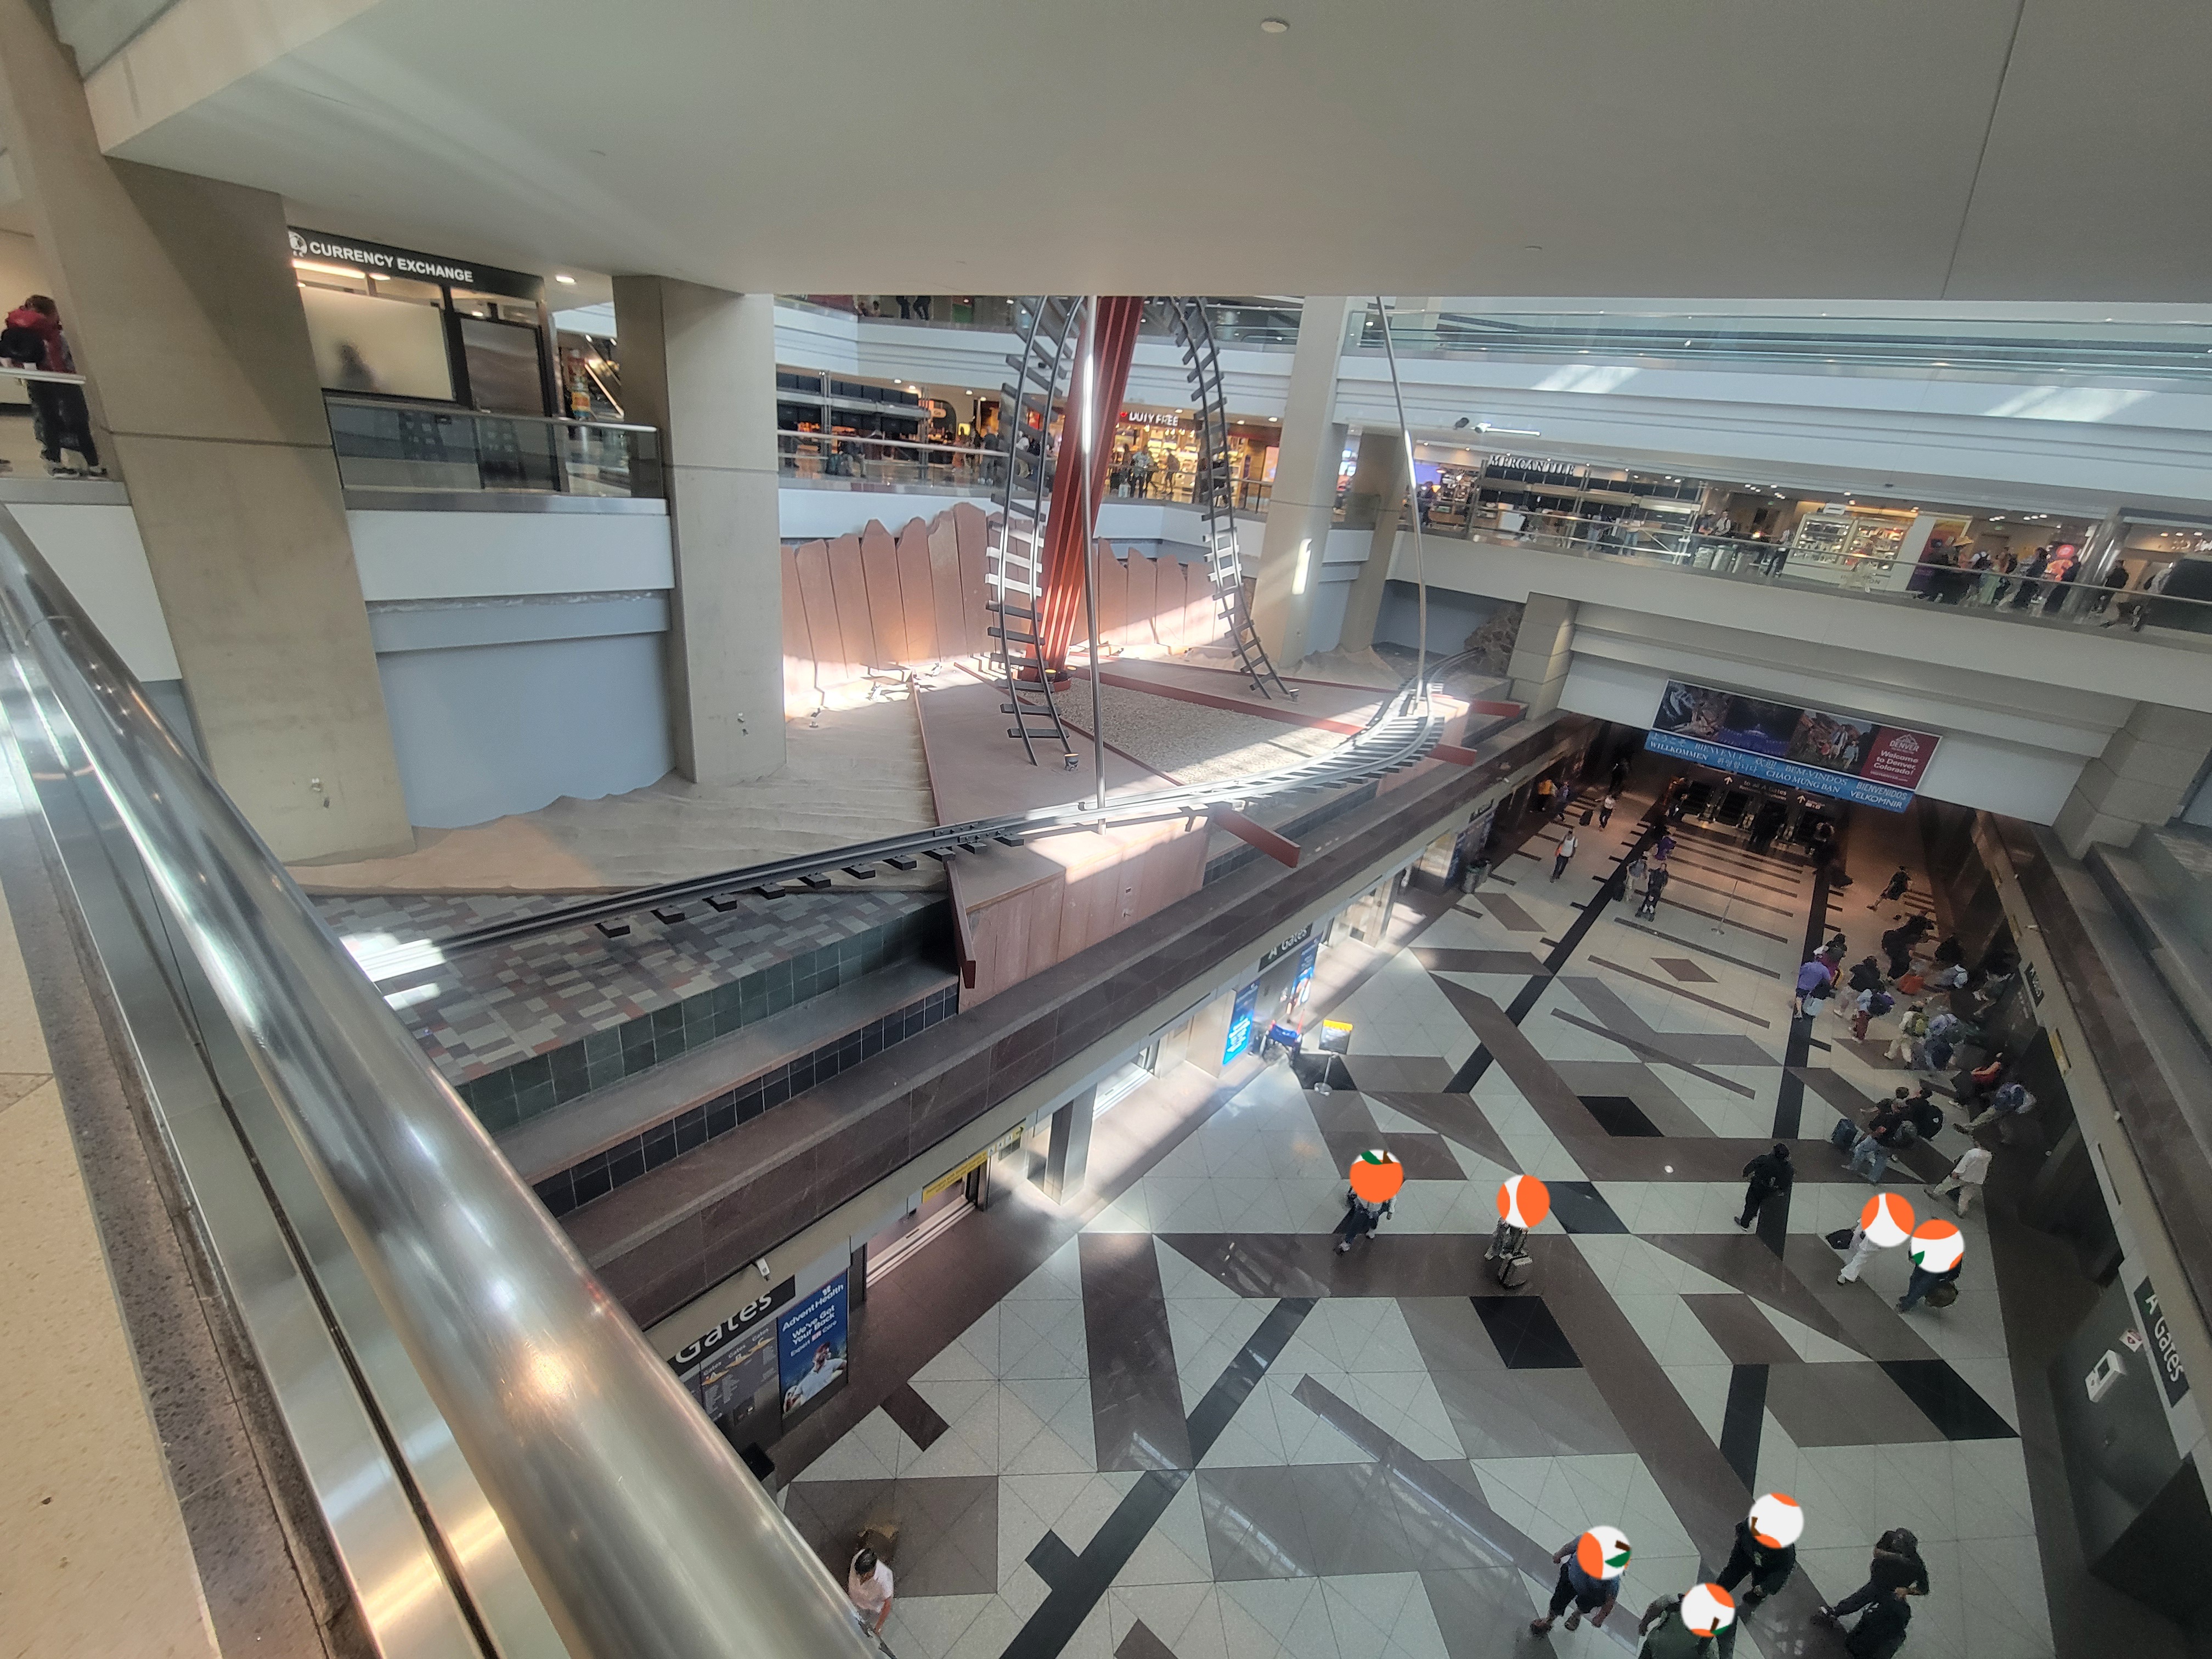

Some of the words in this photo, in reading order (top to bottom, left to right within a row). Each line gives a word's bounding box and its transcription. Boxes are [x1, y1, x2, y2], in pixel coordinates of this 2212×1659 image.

[309, 241, 394, 268] CURRENCY
[397, 257, 473, 283] EXCHANGE
[1128, 410, 1155, 424] DUTY
[1155, 413, 1179, 426] FREE
[1488, 455, 1575, 476] MERCANTILE
[1650, 741, 1708, 761] WILLKOMMEN
[1889, 740, 1920, 752] DENVER
[1881, 750, 1918, 763] Welcome
[1785, 764, 1848, 786] BEM-VINDOS
[1874, 762, 1914, 775] Colorado!
[1850, 791, 1903, 809] VELKOMNIR
[1856, 781, 1908, 800] BIENVENIDOS
[782, 1284, 844, 1331] AdventHealth
[820, 1305, 835, 1319] Got
[675, 1291, 772, 1363] Gates
[792, 1328, 812, 1345] Your
[814, 1312, 835, 1331] Back
[2145, 1294, 2158, 1315] A
[2154, 1317, 2184, 1382] Gates
